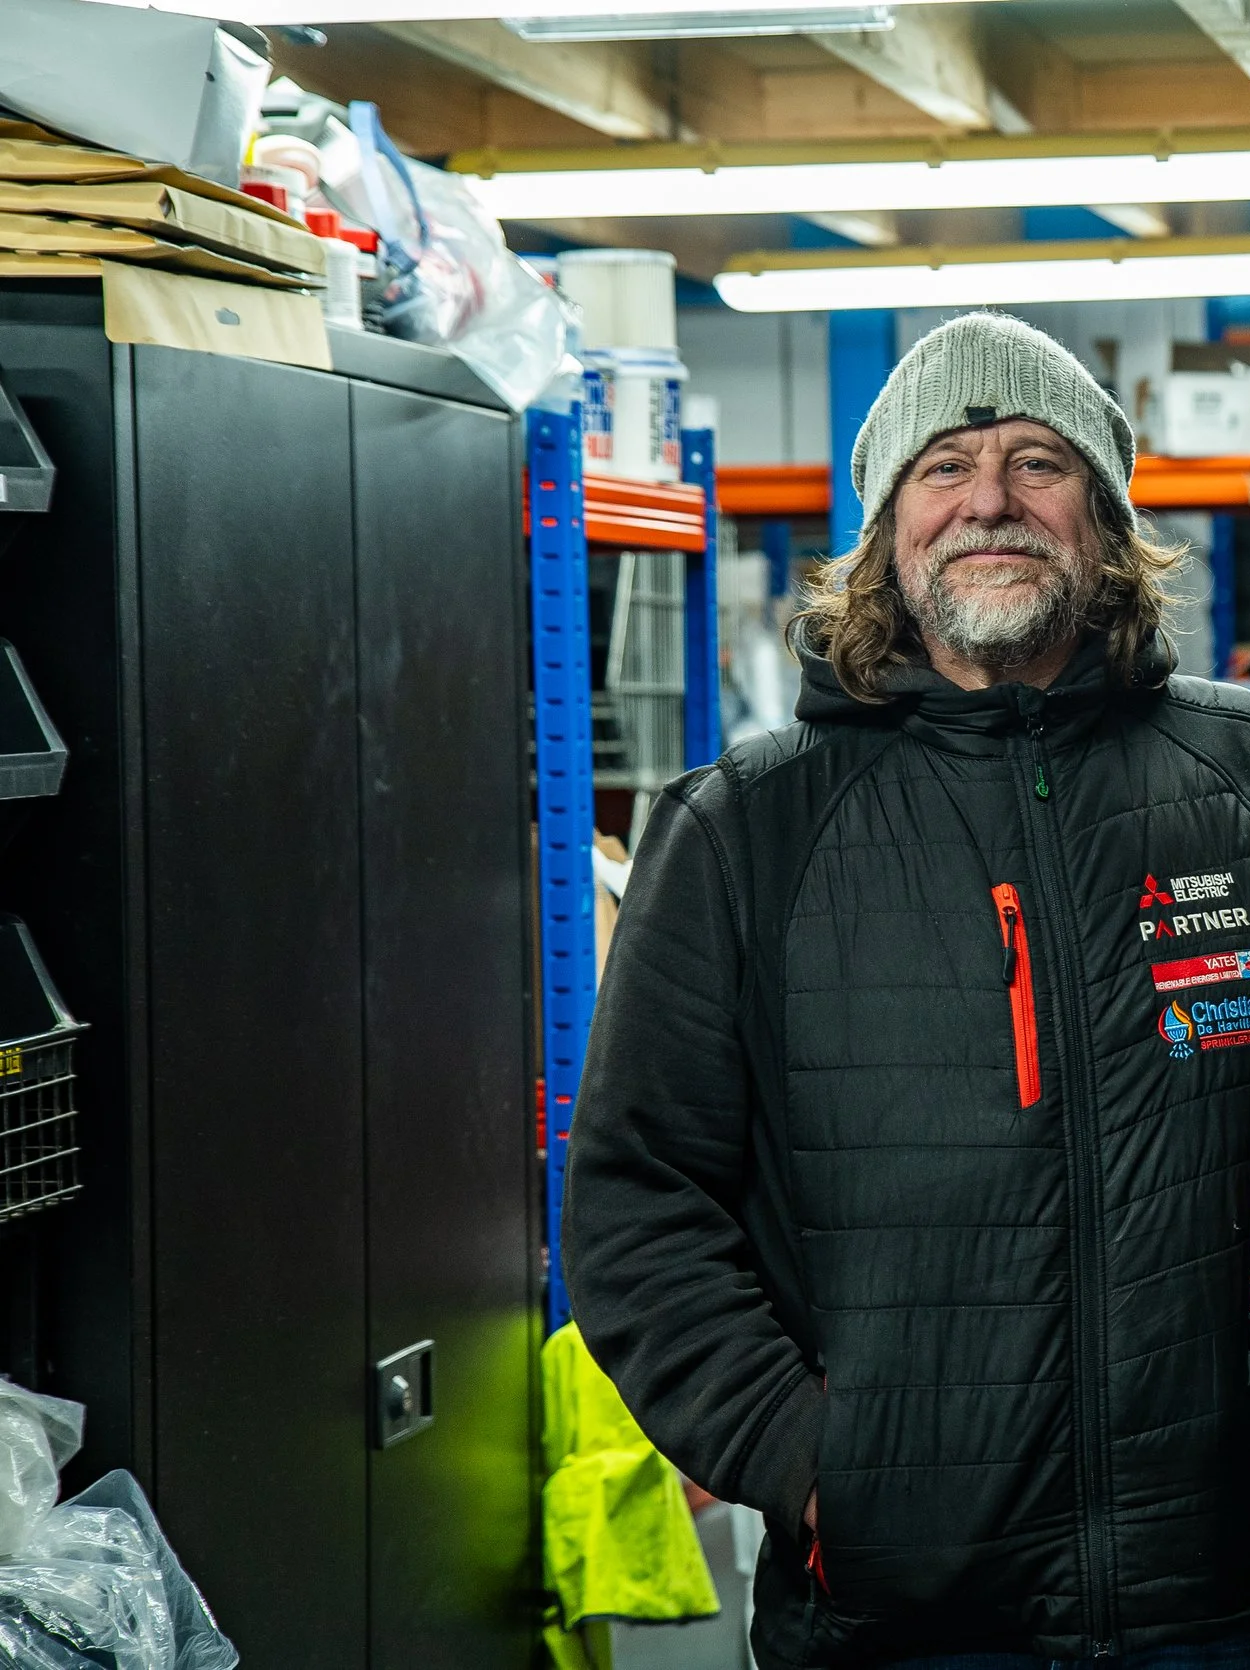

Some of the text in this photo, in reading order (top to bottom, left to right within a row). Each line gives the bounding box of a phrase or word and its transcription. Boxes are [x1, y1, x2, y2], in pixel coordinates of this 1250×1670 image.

[1170, 872, 1235, 891] MITSUBISHI
[1174, 885, 1230, 902] ELECTRIC
[1139, 907, 1250, 941] PARTNER
[1204, 956, 1236, 969] YATES
[1196, 1024, 1213, 1036] De
